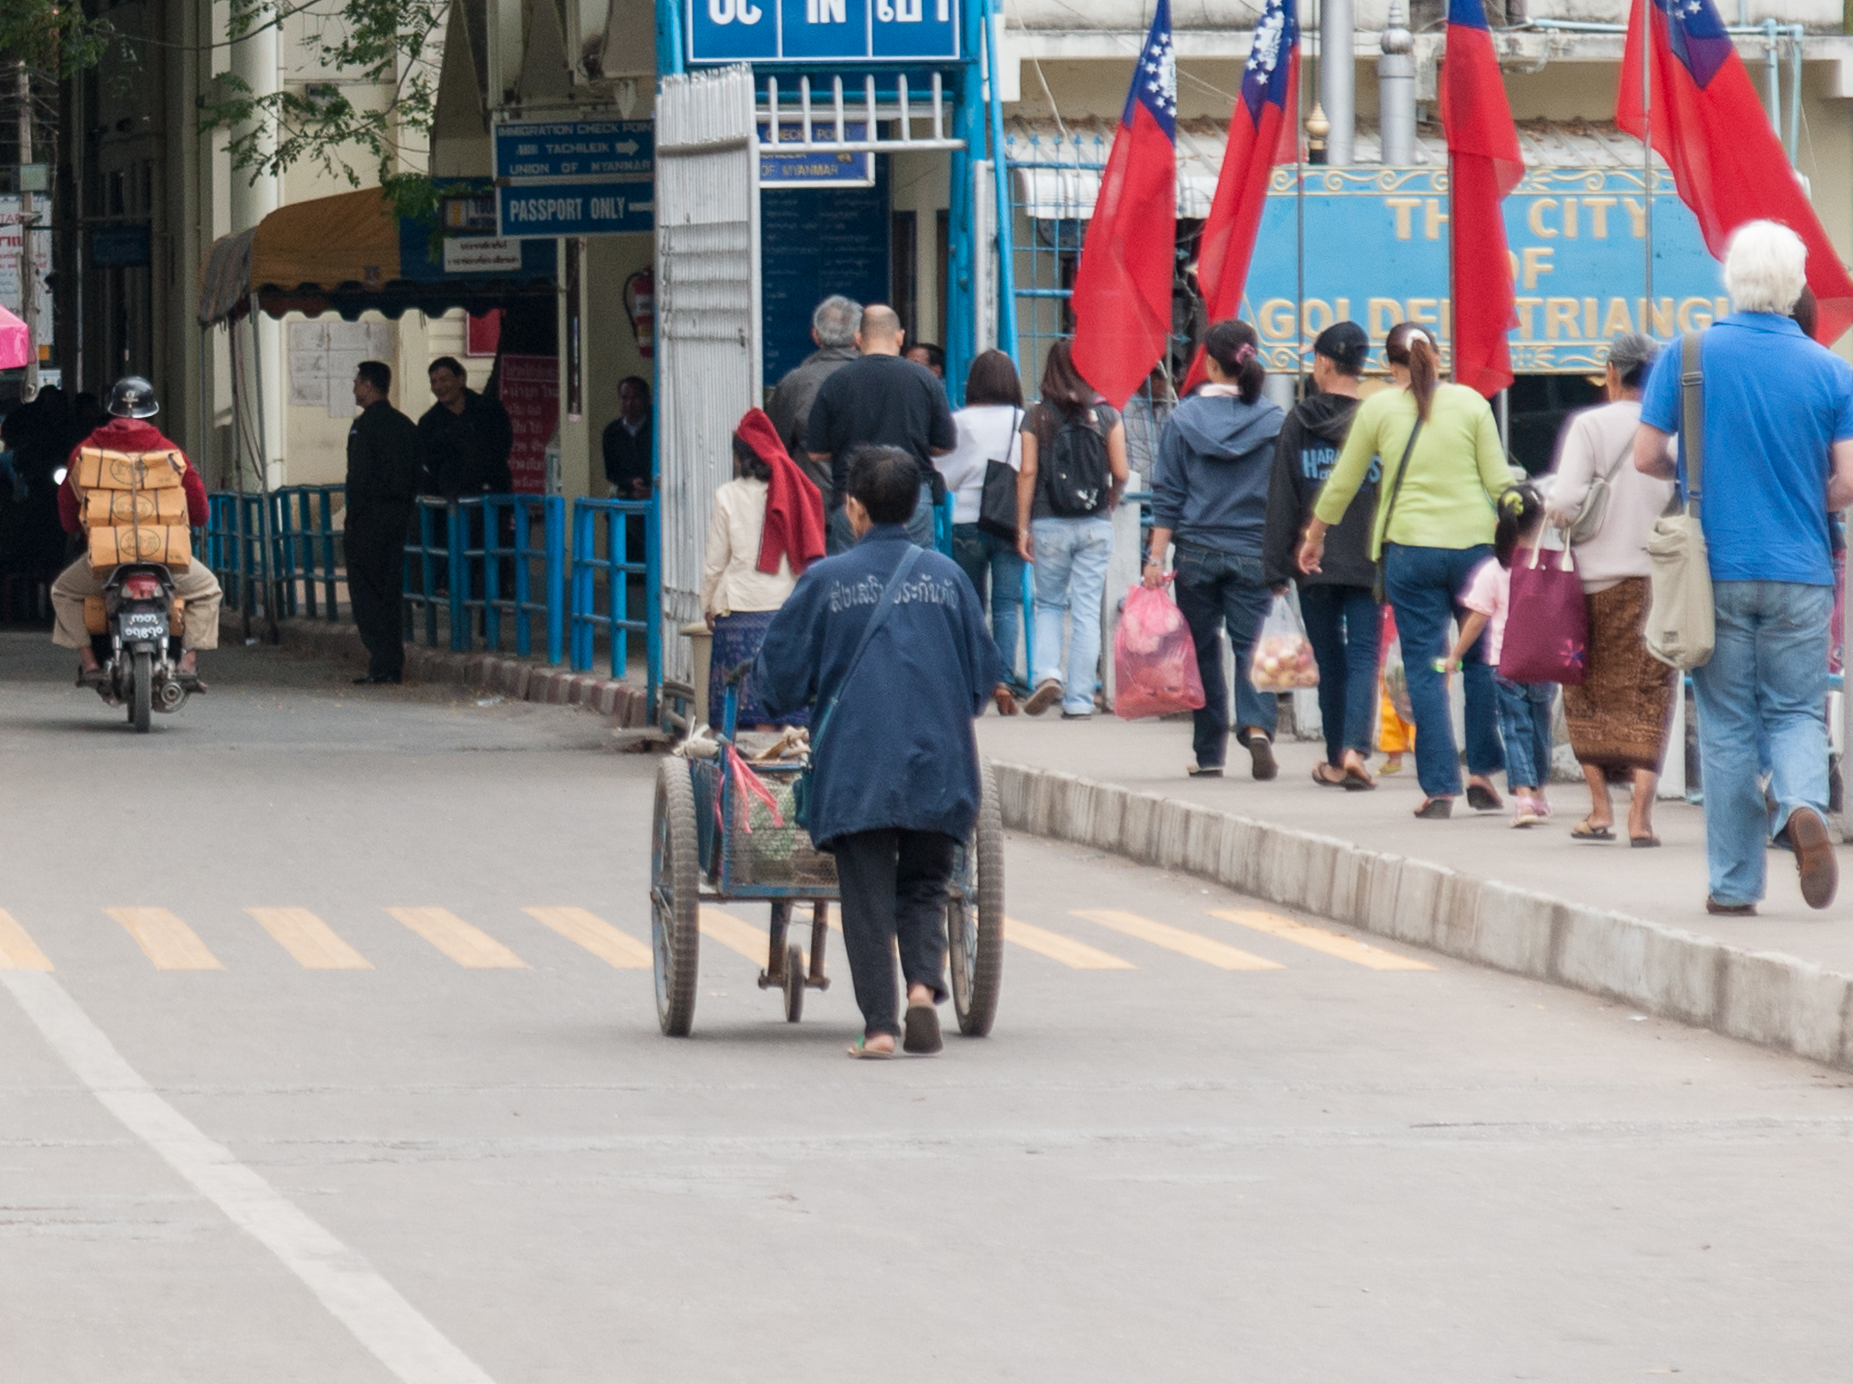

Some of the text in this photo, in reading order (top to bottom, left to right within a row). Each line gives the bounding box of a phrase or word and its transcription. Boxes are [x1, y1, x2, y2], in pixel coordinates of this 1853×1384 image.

[498, 124, 573, 137] IMMIGRATION
[577, 123, 619, 135] CHECK
[545, 142, 611, 155] TACHILEIK
[509, 160, 652, 176] UNION OF MYANMAR
[509, 198, 583, 223] PASSPORT
[590, 196, 626, 220] ONLY
[1385, 197, 1656, 240] TH CITY
